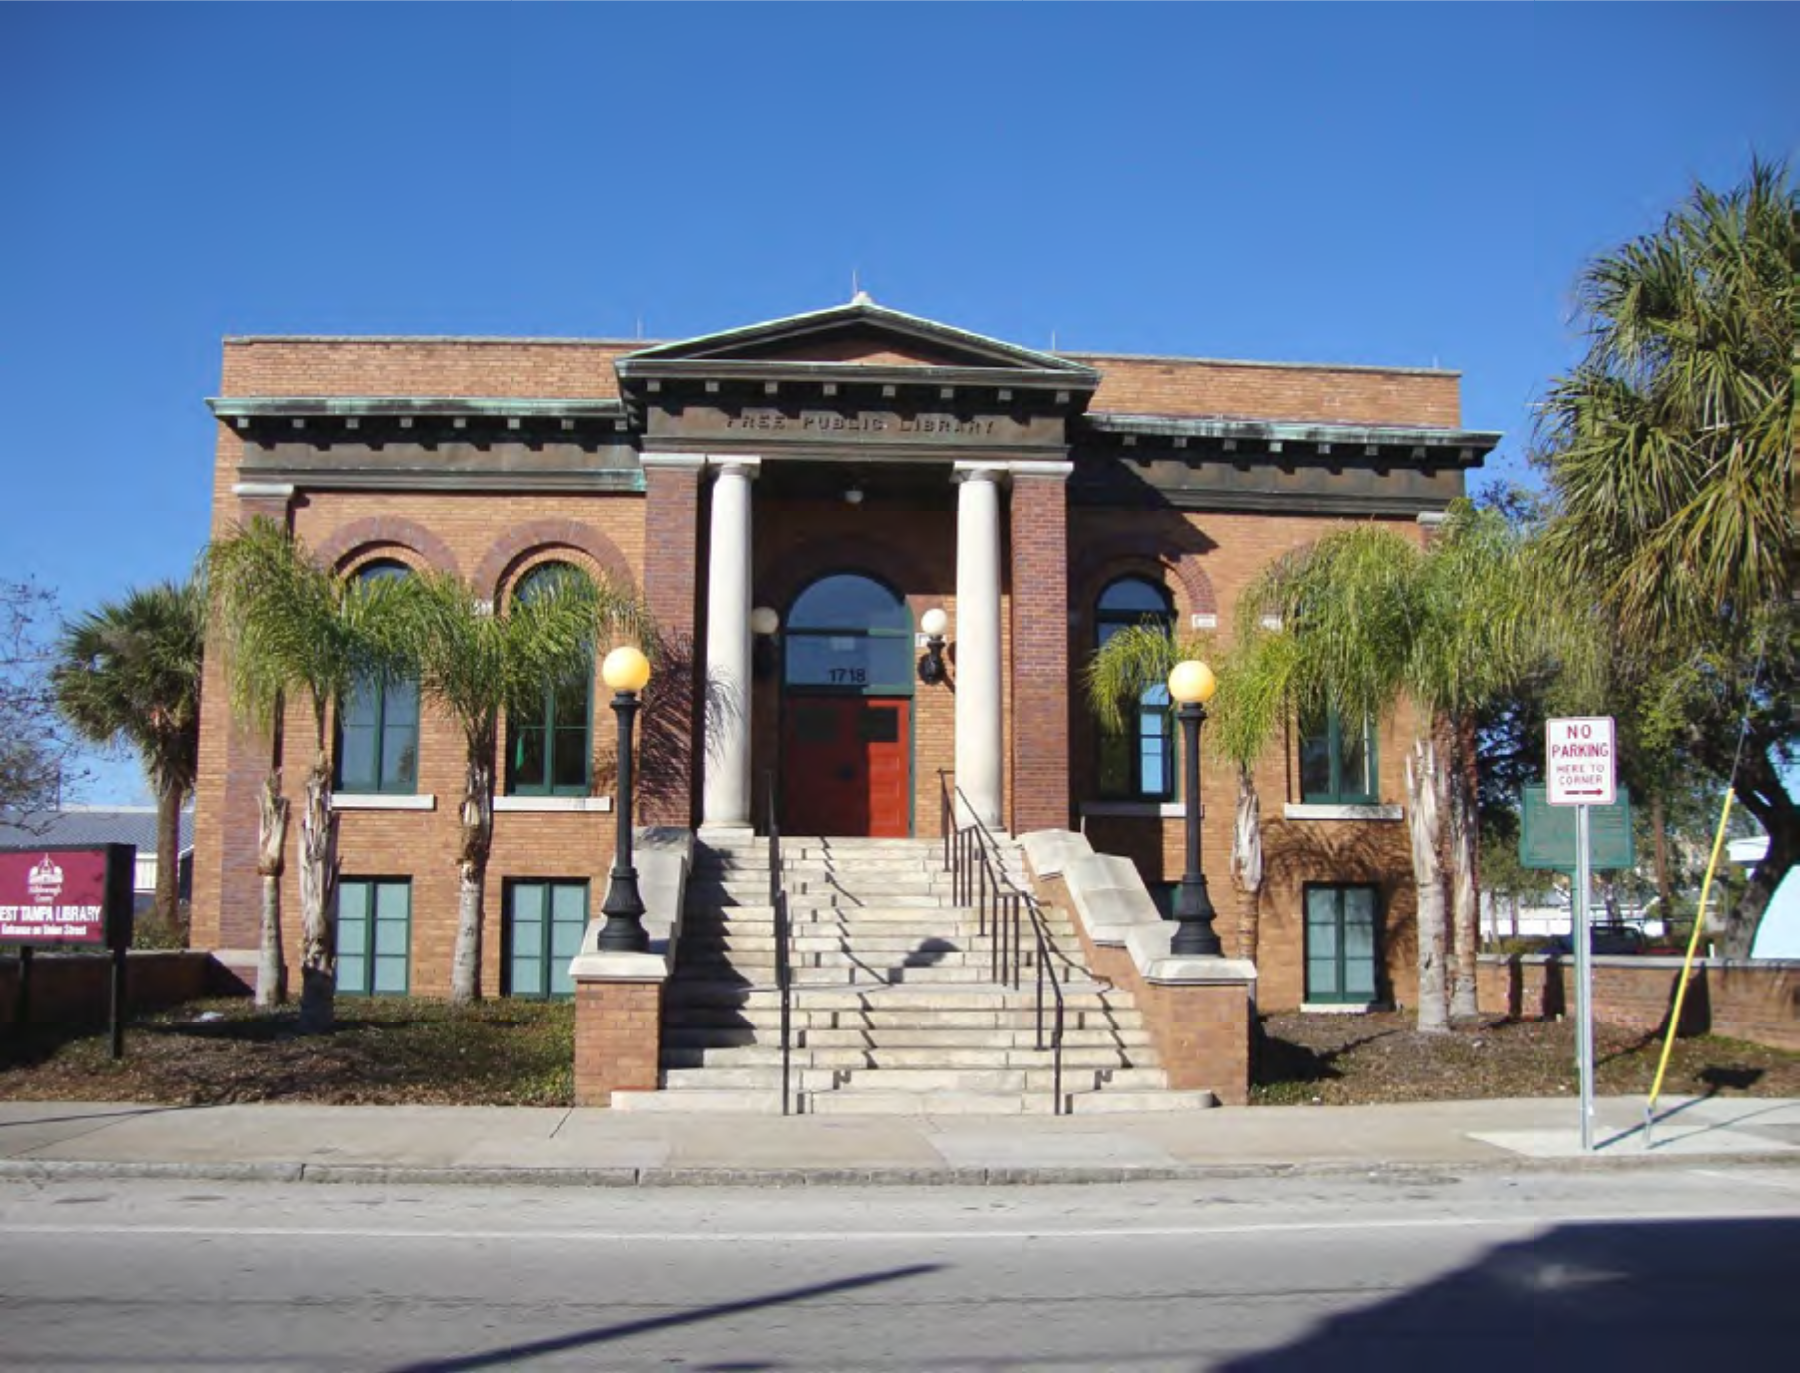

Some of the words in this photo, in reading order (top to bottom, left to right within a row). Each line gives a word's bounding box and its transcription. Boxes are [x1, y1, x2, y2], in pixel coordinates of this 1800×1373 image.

[726, 416, 786, 430] FREE
[802, 417, 884, 431] PUBLIC
[899, 419, 994, 434] LIBRARY
[829, 668, 866, 683] 1718
[1566, 724, 1592, 739] NO
[1551, 742, 1609, 758] PARKING
[1556, 764, 1585, 773] HERE
[1591, 764, 1605, 773] TO
[1558, 775, 1603, 786] CORNER
[20, 905, 54, 921] TAMPA
[55, 905, 102, 921] LIBRARY
